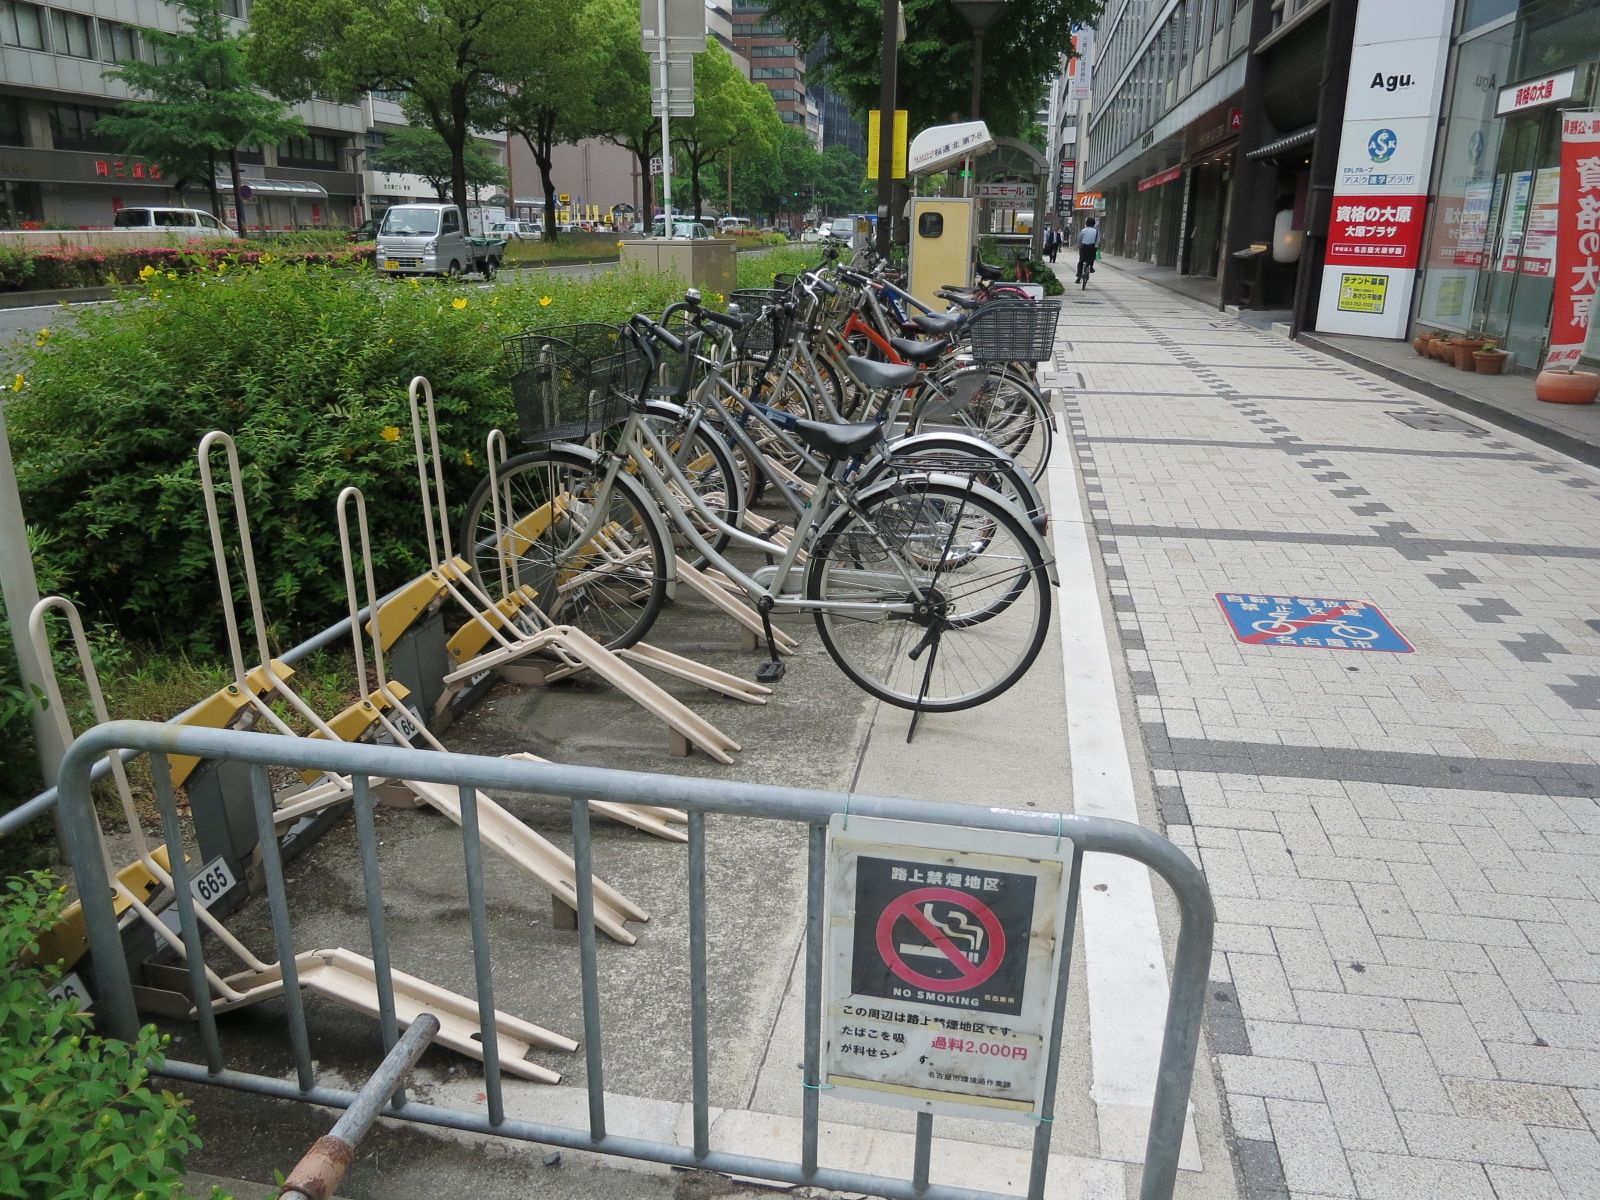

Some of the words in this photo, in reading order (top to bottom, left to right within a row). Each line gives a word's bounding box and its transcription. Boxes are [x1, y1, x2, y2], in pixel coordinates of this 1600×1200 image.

[1370, 72, 1416, 92] Agu.
[1514, 79, 1554, 107] 資格の大原
[982, 186, 1025, 197] ユニモール
[1080, 195, 1095, 206] au
[1335, 205, 1412, 223] 資格の大原
[1344, 225, 1397, 238] 大原プラザ
[1226, 594, 1367, 610] 自転車等放置
[1241, 603, 1364, 618] 禁止区域
[1275, 635, 1374, 649] 名古屋市
[197, 865, 228, 901] 665
[891, 866, 1000, 892] 路上禁煙地区
[893, 987, 912, 998] NO
[916, 990, 980, 1007] SMOKING
[931, 1036, 1028, 1061] 過料2,000円
